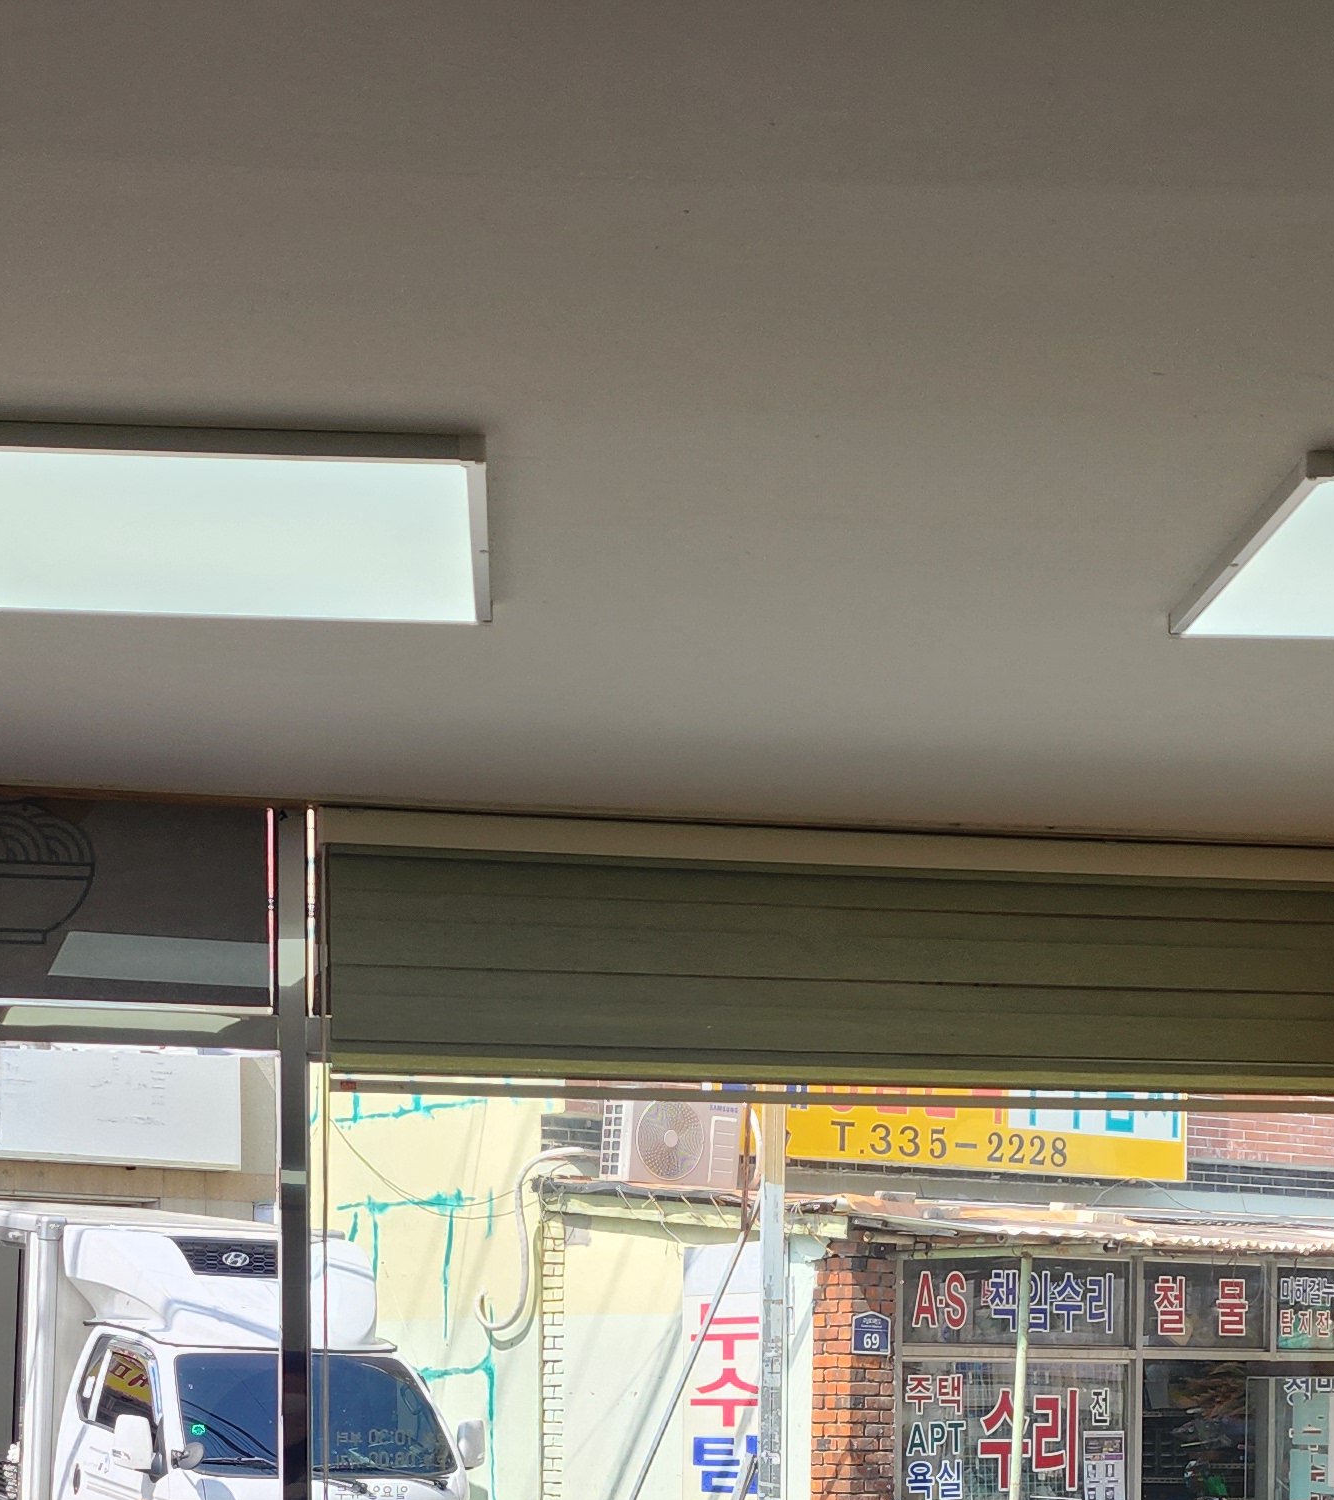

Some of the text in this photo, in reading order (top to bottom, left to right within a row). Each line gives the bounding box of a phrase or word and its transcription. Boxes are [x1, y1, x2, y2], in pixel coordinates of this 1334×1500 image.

[709, 1104, 739, 1114] SAMSUNG
[830, 1118, 1069, 1168] T.335-2228
[987, 1268, 1115, 1335] 책임수리
[1153, 1275, 1249, 1337] 철물
[863, 1332, 880, 1349] 69
[904, 1373, 964, 1416] 주택
[905, 1420, 967, 1457] APT
[977, 1387, 1080, 1492] 수리
